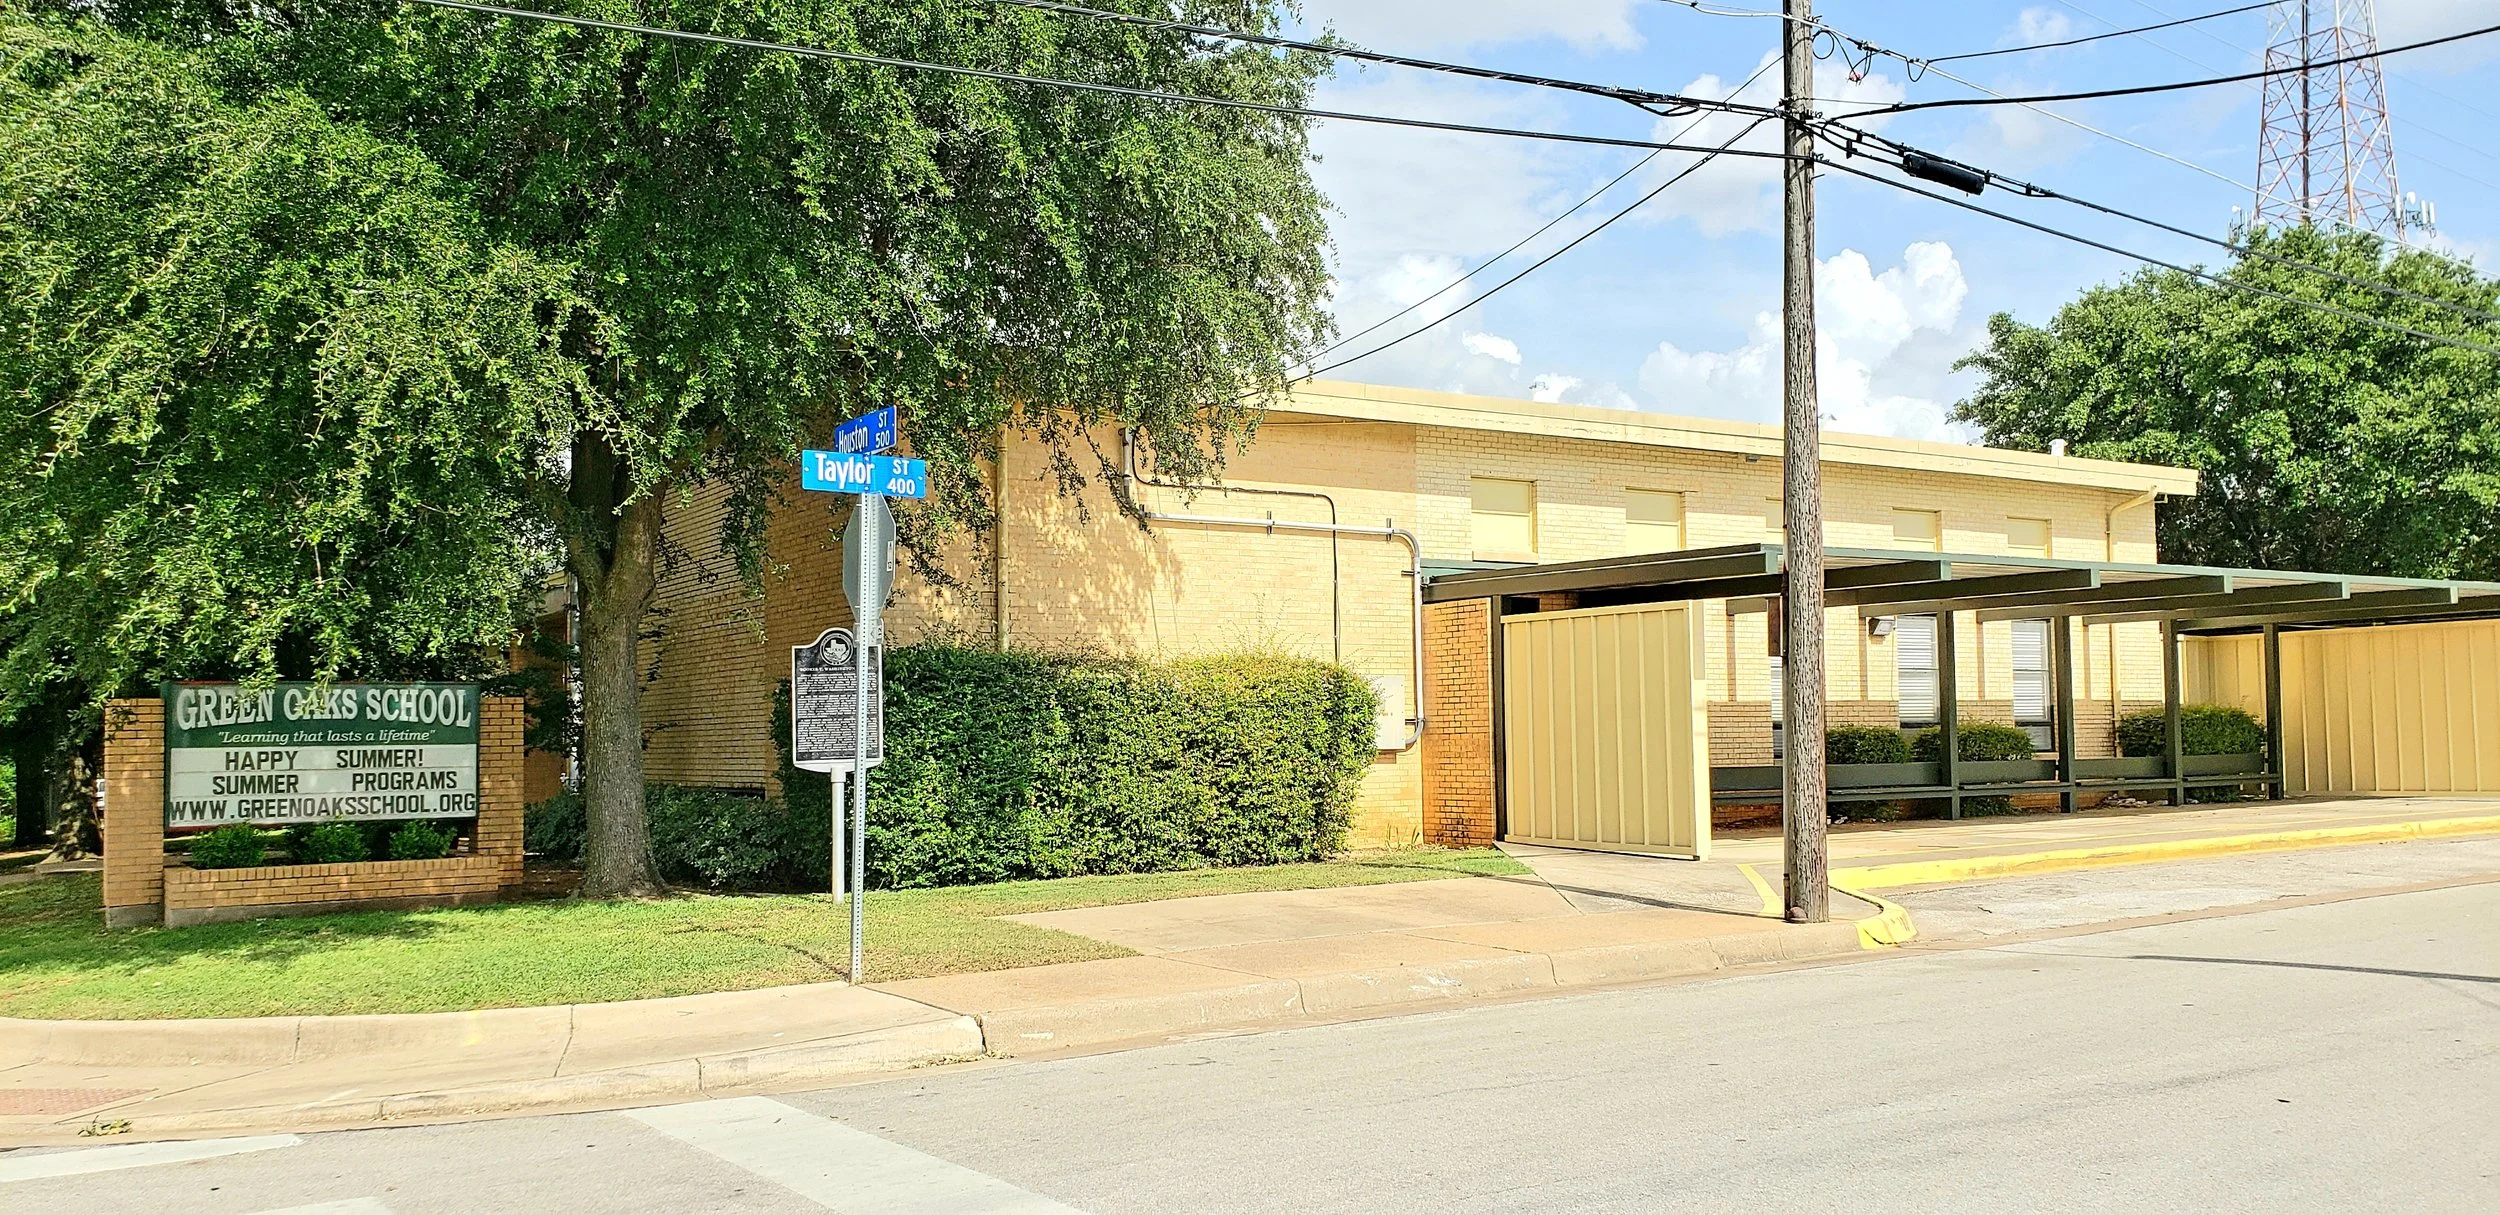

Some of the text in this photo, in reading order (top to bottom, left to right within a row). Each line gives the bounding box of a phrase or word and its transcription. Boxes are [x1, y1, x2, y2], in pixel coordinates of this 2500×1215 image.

[838, 411, 888, 454] Houston ST
[875, 430, 890, 448] 500
[815, 452, 909, 489] Taylor ST
[887, 478, 915, 495] 400
[176, 688, 275, 730] GREEN
[366, 688, 472, 728] SCHOOL
[293, 731, 323, 742] that
[327, 730, 362, 742] lasts
[365, 732, 375, 741] a
[225, 748, 423, 771] HAPPY SUMMER!
[212, 771, 457, 795] SUMMER PROGRAMS
[170, 793, 476, 820] WWW.GREENOAKSSCHOOL.ORG
